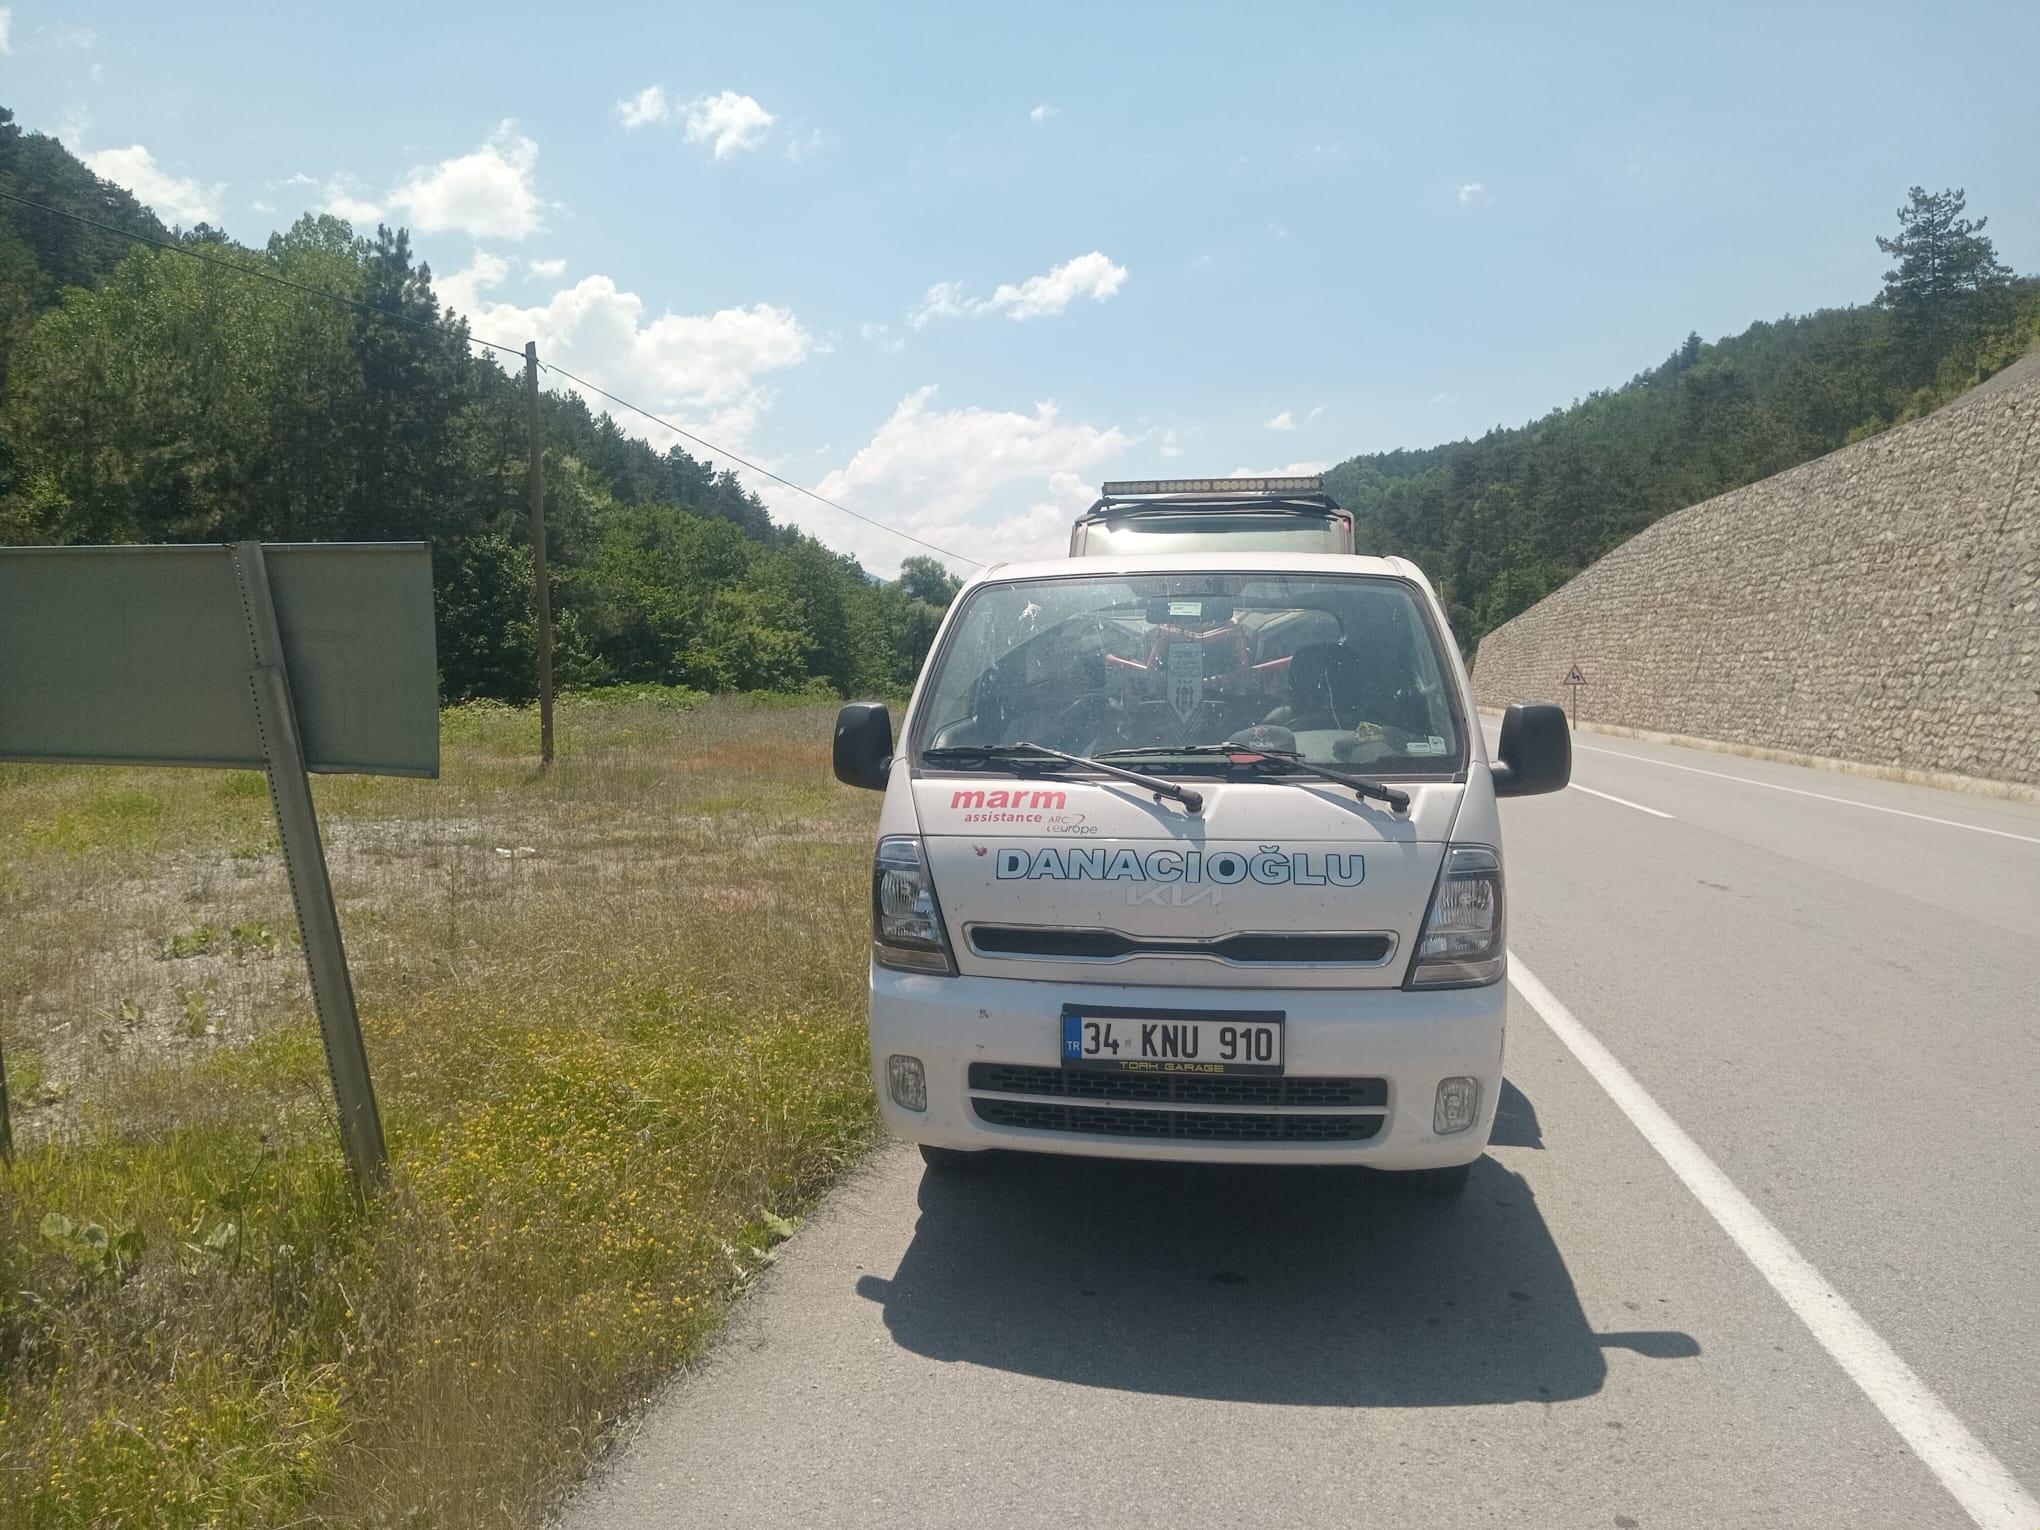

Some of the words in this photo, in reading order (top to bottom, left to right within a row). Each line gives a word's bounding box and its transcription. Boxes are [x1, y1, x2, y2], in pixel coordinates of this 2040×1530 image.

[951, 790, 1067, 810] marm
[964, 811, 1042, 823] assistance
[1048, 814, 1070, 824] ARC
[1051, 823, 1098, 836] europe
[996, 845, 1365, 887] DANACIOĞLU
[1066, 1040, 1080, 1051] TR
[1084, 1023, 1120, 1056] 34
[1142, 1024, 1199, 1058] KNU
[1220, 1027, 1272, 1062] 910
[1120, 1061, 1158, 1071] TORK
[1164, 1062, 1224, 1073] GARAGE
